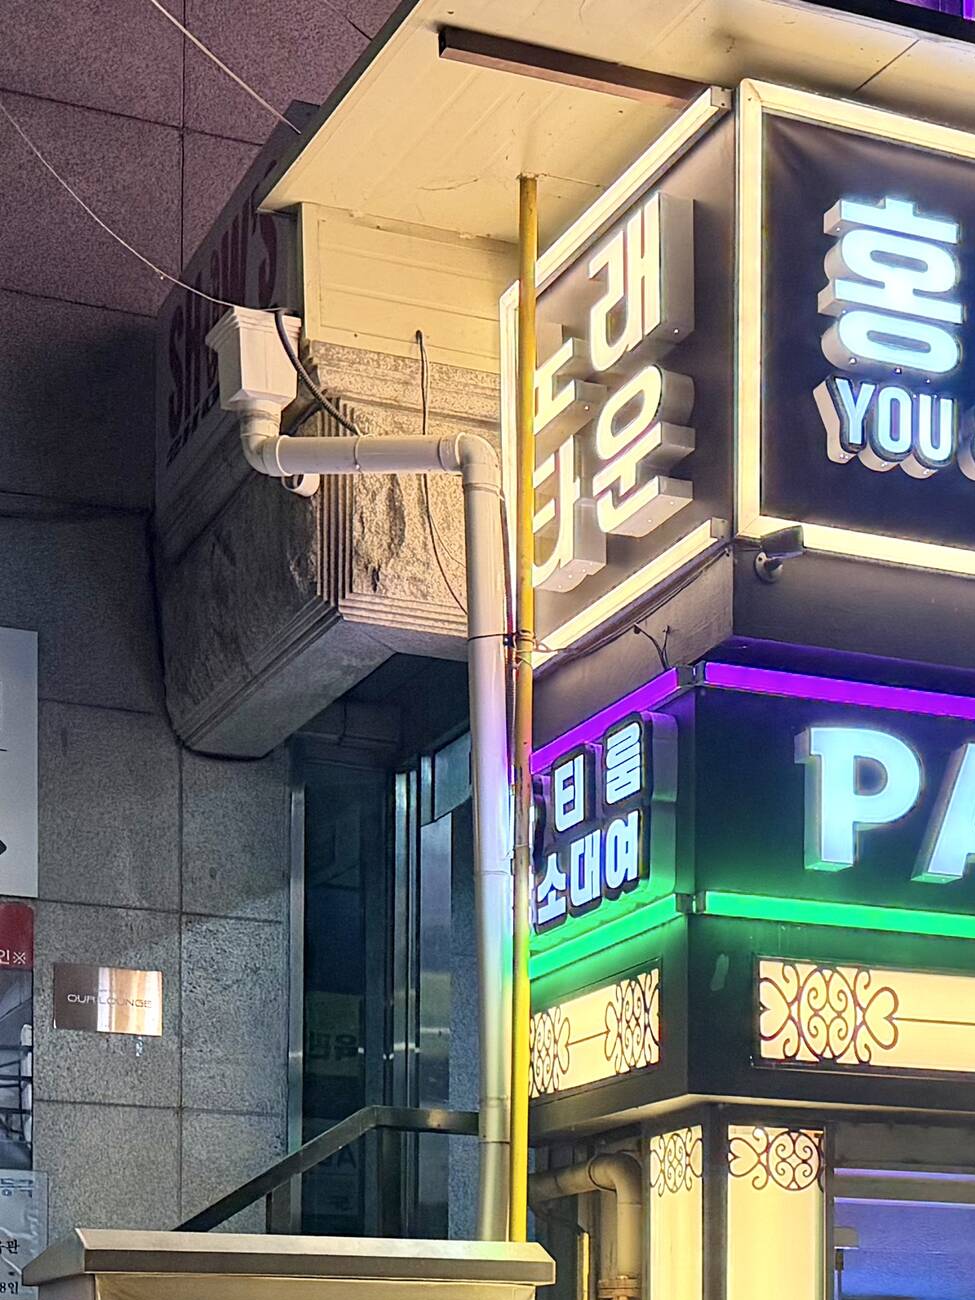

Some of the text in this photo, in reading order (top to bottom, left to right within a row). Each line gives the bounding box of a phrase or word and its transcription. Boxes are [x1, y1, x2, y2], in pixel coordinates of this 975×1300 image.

[818, 377, 955, 470] YOU
[553, 721, 641, 832] 티룸
[538, 810, 640, 925] 소대여
[99, 997, 152, 1009] LOUNGE
